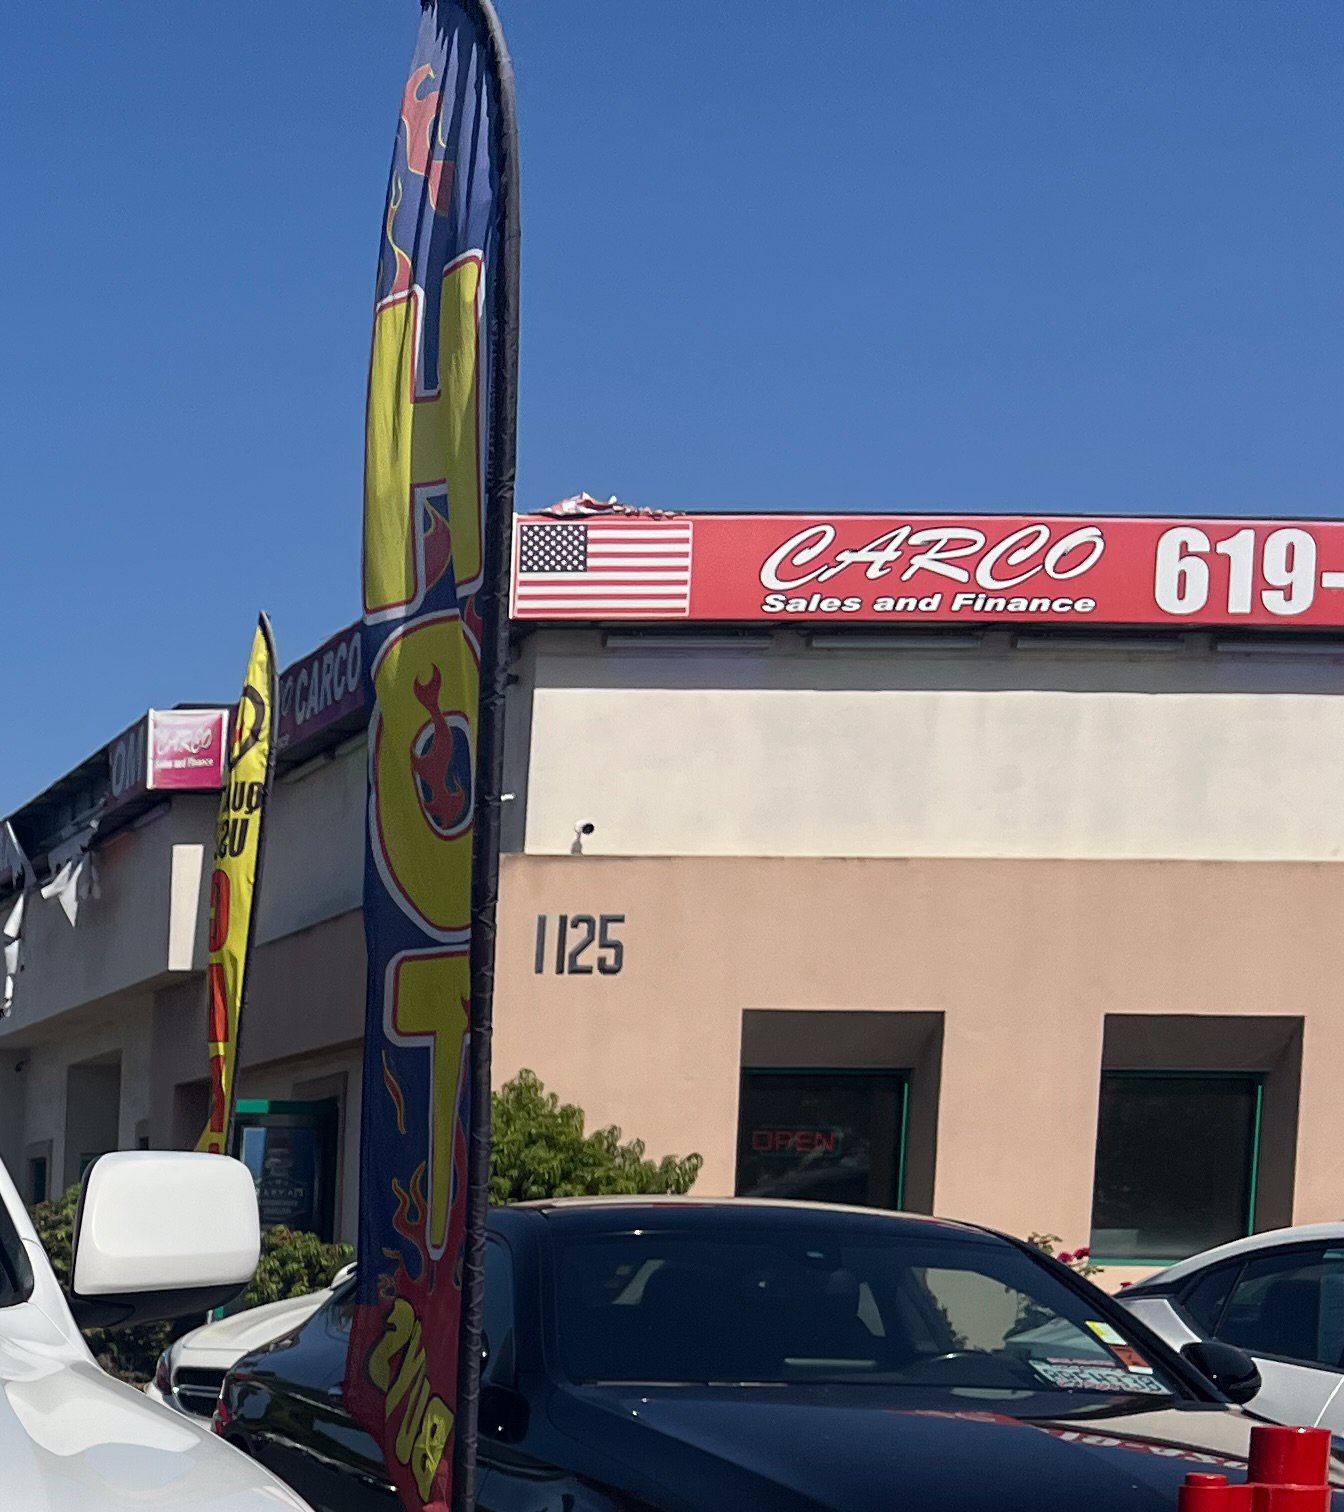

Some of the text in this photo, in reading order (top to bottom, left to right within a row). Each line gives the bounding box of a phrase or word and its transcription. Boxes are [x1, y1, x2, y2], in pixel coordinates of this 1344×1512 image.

[759, 523, 1106, 591] CARCO
[761, 593, 1097, 614] Sales and Finance
[295, 631, 362, 726] CARCO
[362, 249, 484, 1262] HOT
[534, 913, 626, 976] 1125
[752, 1130, 837, 1154] OPEN
